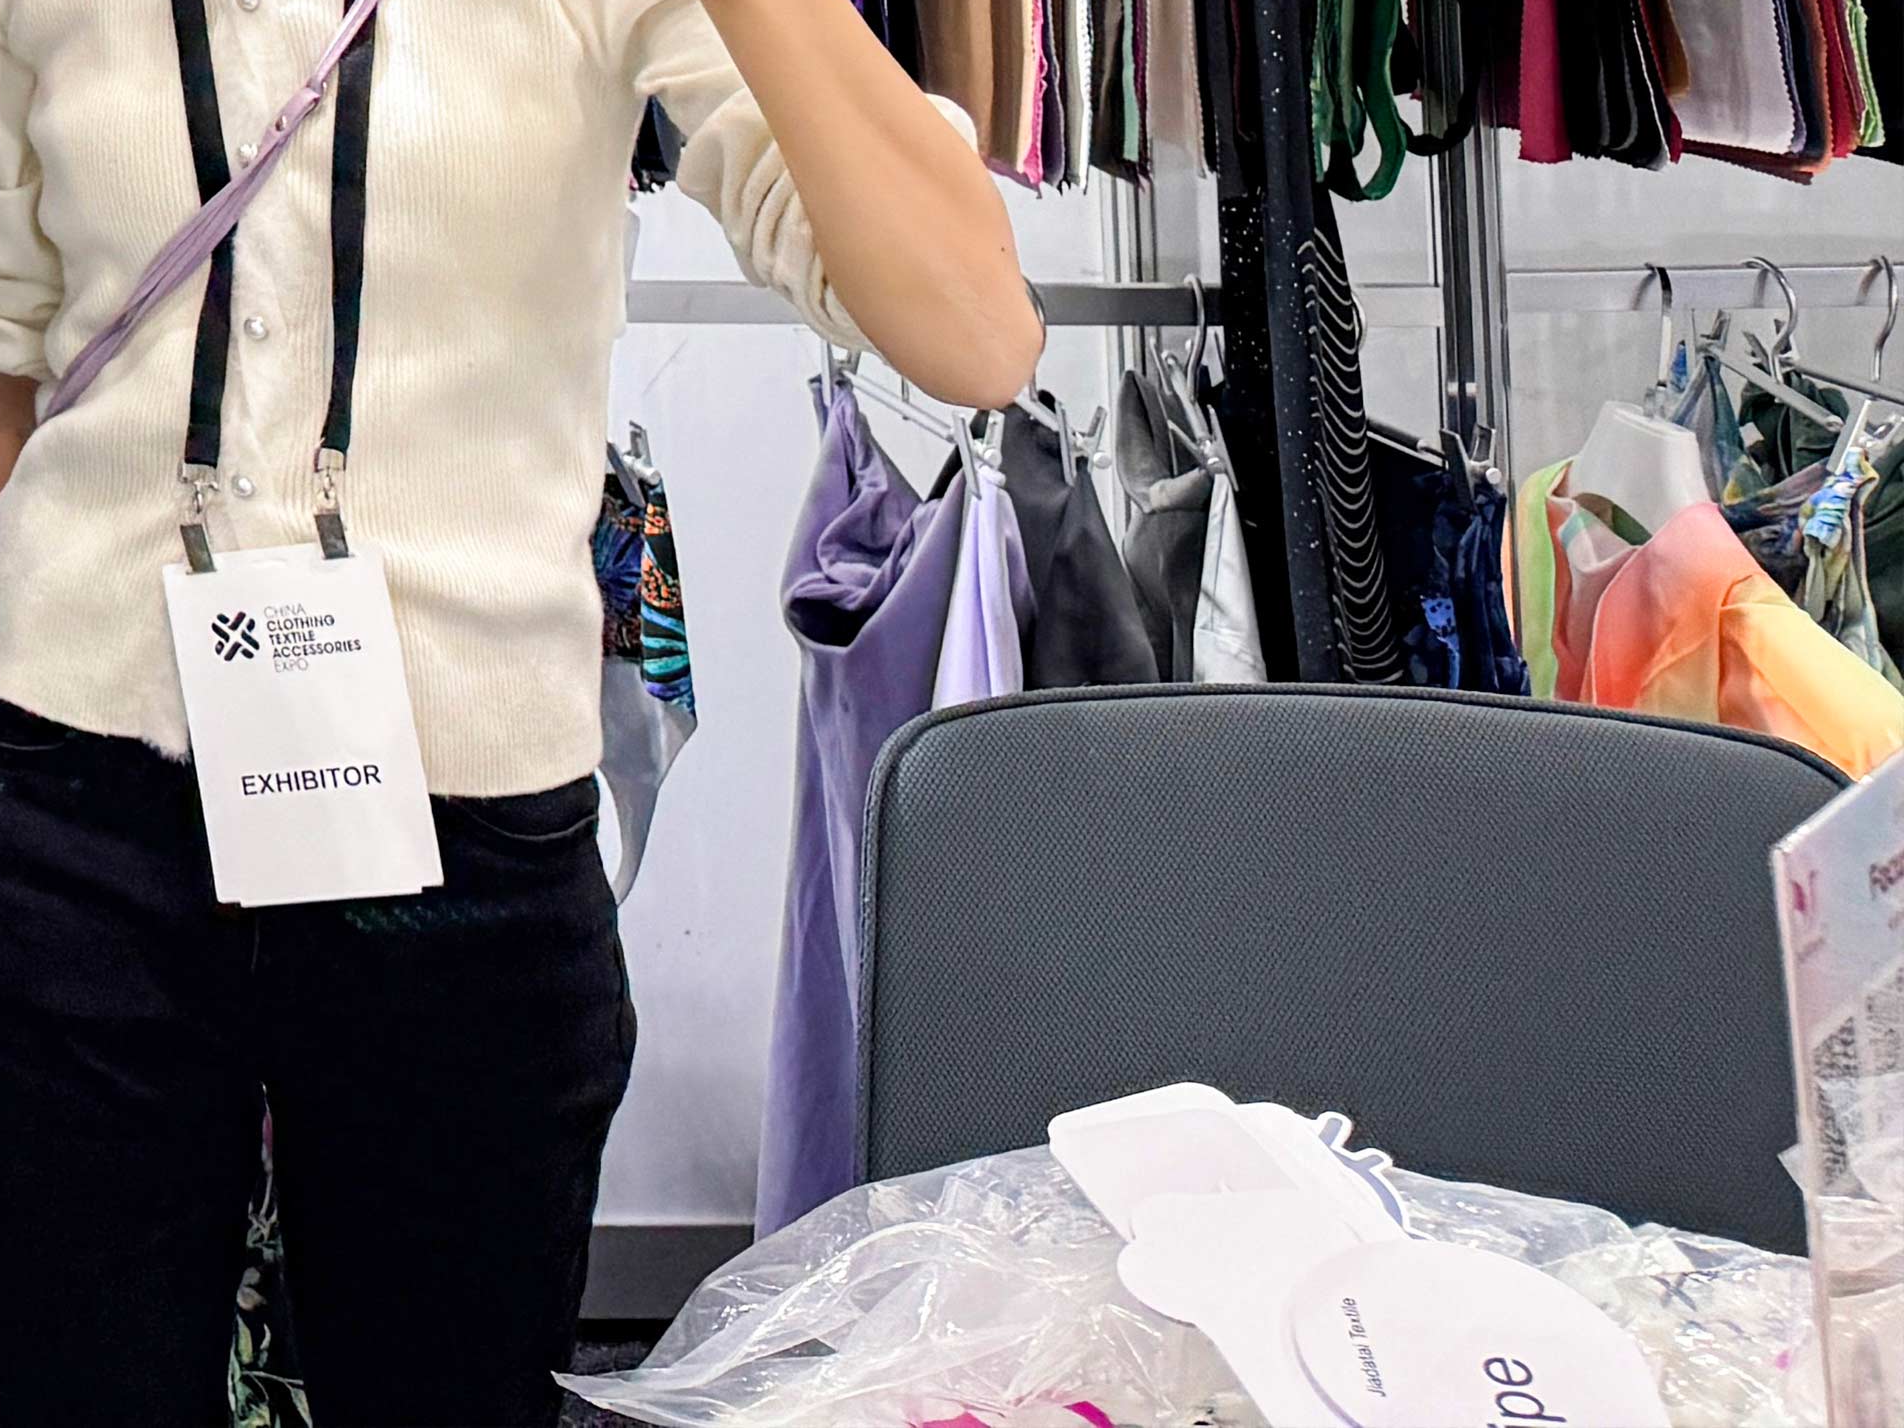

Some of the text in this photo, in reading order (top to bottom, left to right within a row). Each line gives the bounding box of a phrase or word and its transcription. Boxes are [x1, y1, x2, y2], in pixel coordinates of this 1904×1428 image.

[263, 602, 306, 620] CHINA
[266, 614, 336, 632] CLOTHING
[269, 630, 316, 646] TEXTILE
[272, 639, 362, 659] ACCESSORIES
[274, 658, 309, 674] EXPO
[241, 764, 382, 796] EXHIBITOR
